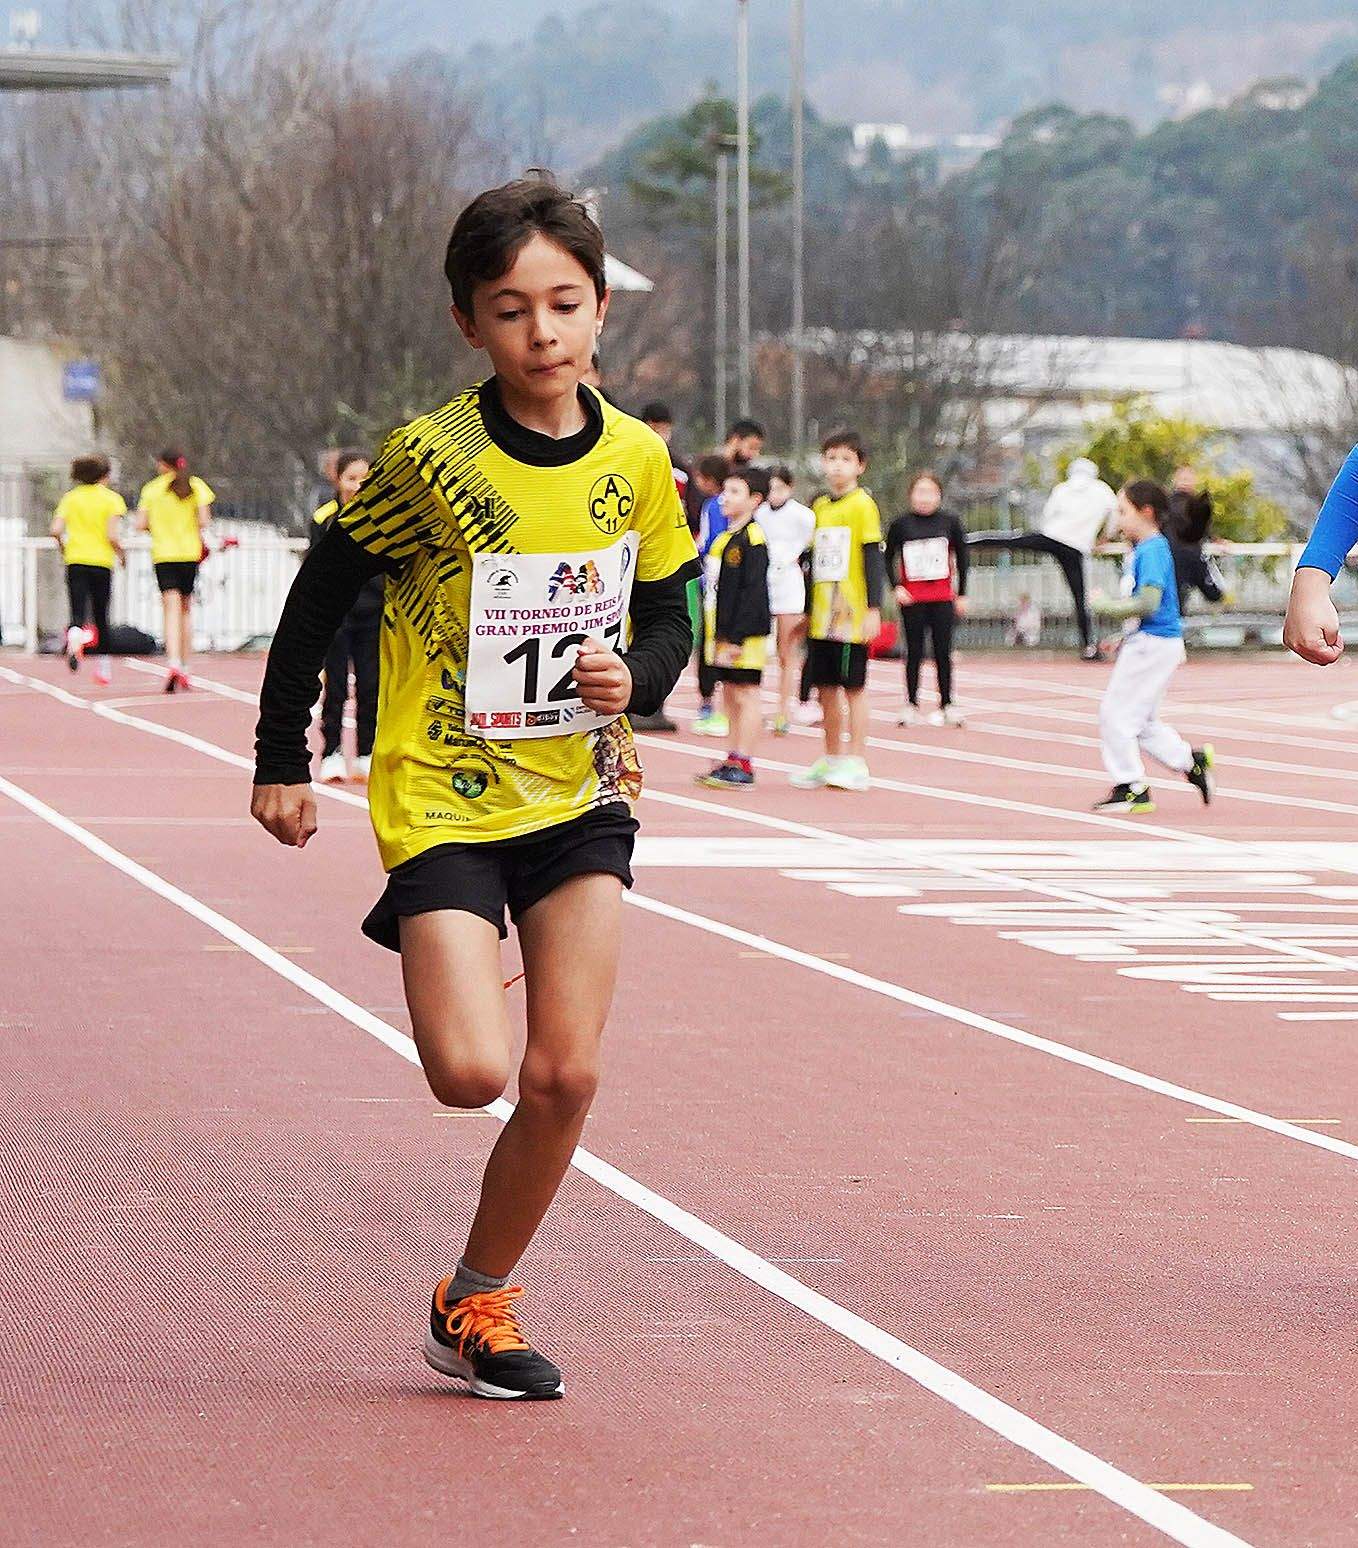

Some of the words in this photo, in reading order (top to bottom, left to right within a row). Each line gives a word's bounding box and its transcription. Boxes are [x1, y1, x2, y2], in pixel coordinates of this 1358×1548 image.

[484, 609, 506, 620] VII
[510, 607, 571, 620] TORNEO
[574, 604, 592, 616] DE
[475, 625, 518, 636] GRAN
[522, 621, 579, 636] PREMIO
[582, 617, 604, 631] JIM
